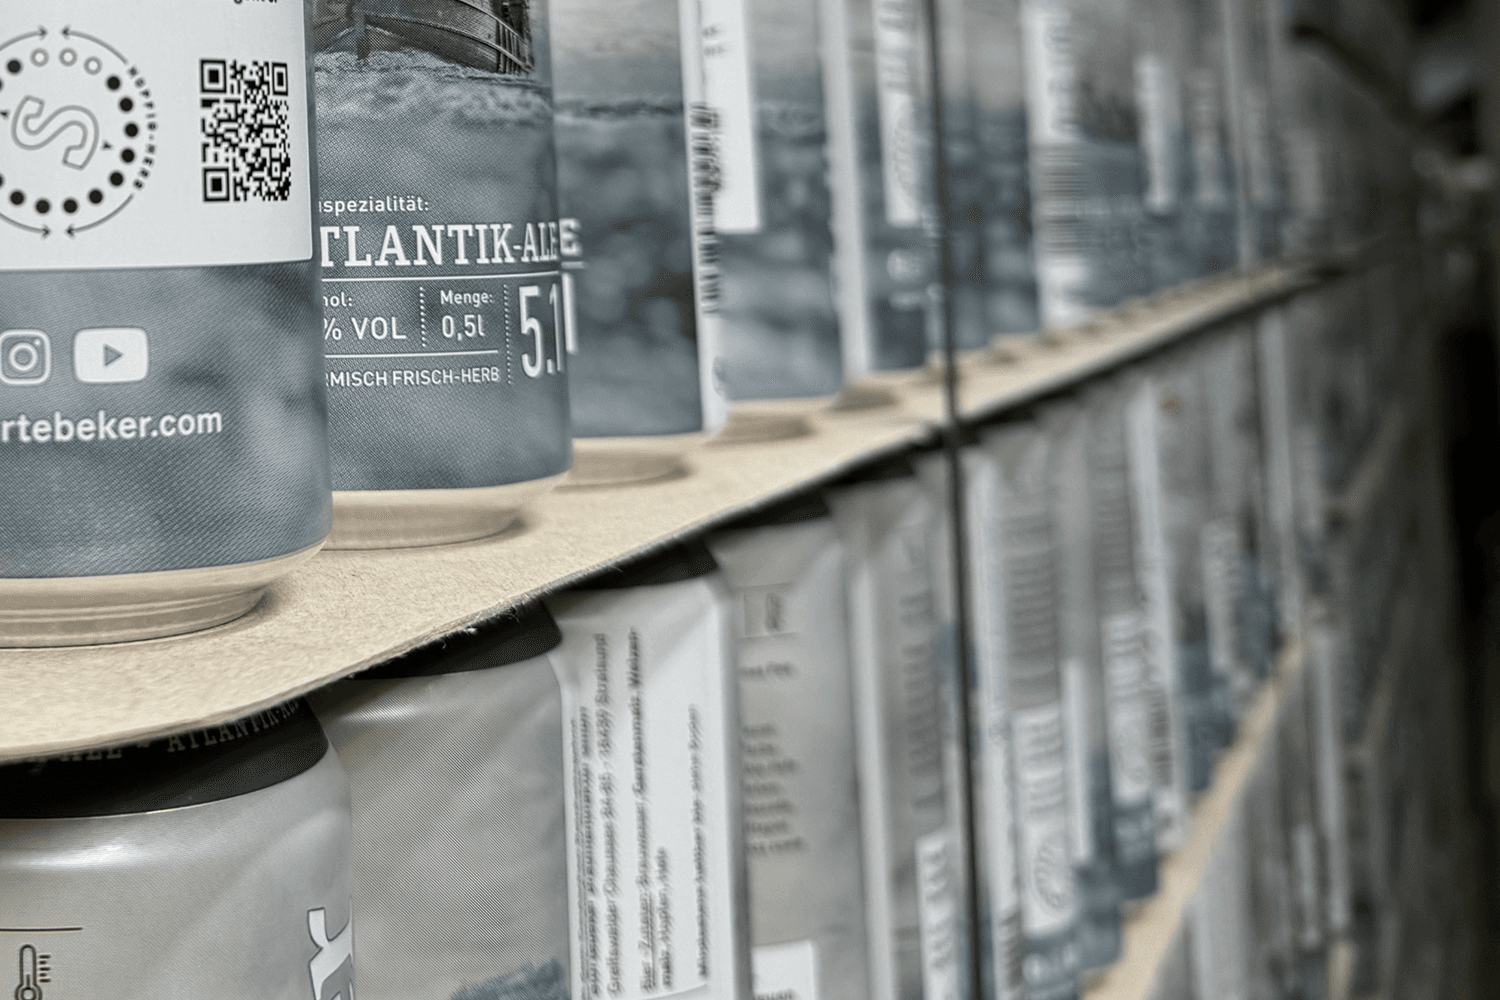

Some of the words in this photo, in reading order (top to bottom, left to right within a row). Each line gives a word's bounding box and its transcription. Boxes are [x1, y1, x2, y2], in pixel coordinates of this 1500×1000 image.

[320, 222, 559, 267] TLANTIK-ALE
[440, 290, 494, 308] Menge:
[351, 316, 407, 341] VOL
[441, 314, 485, 341] 0,5l
[393, 365, 500, 387] FRISCH-HERB
